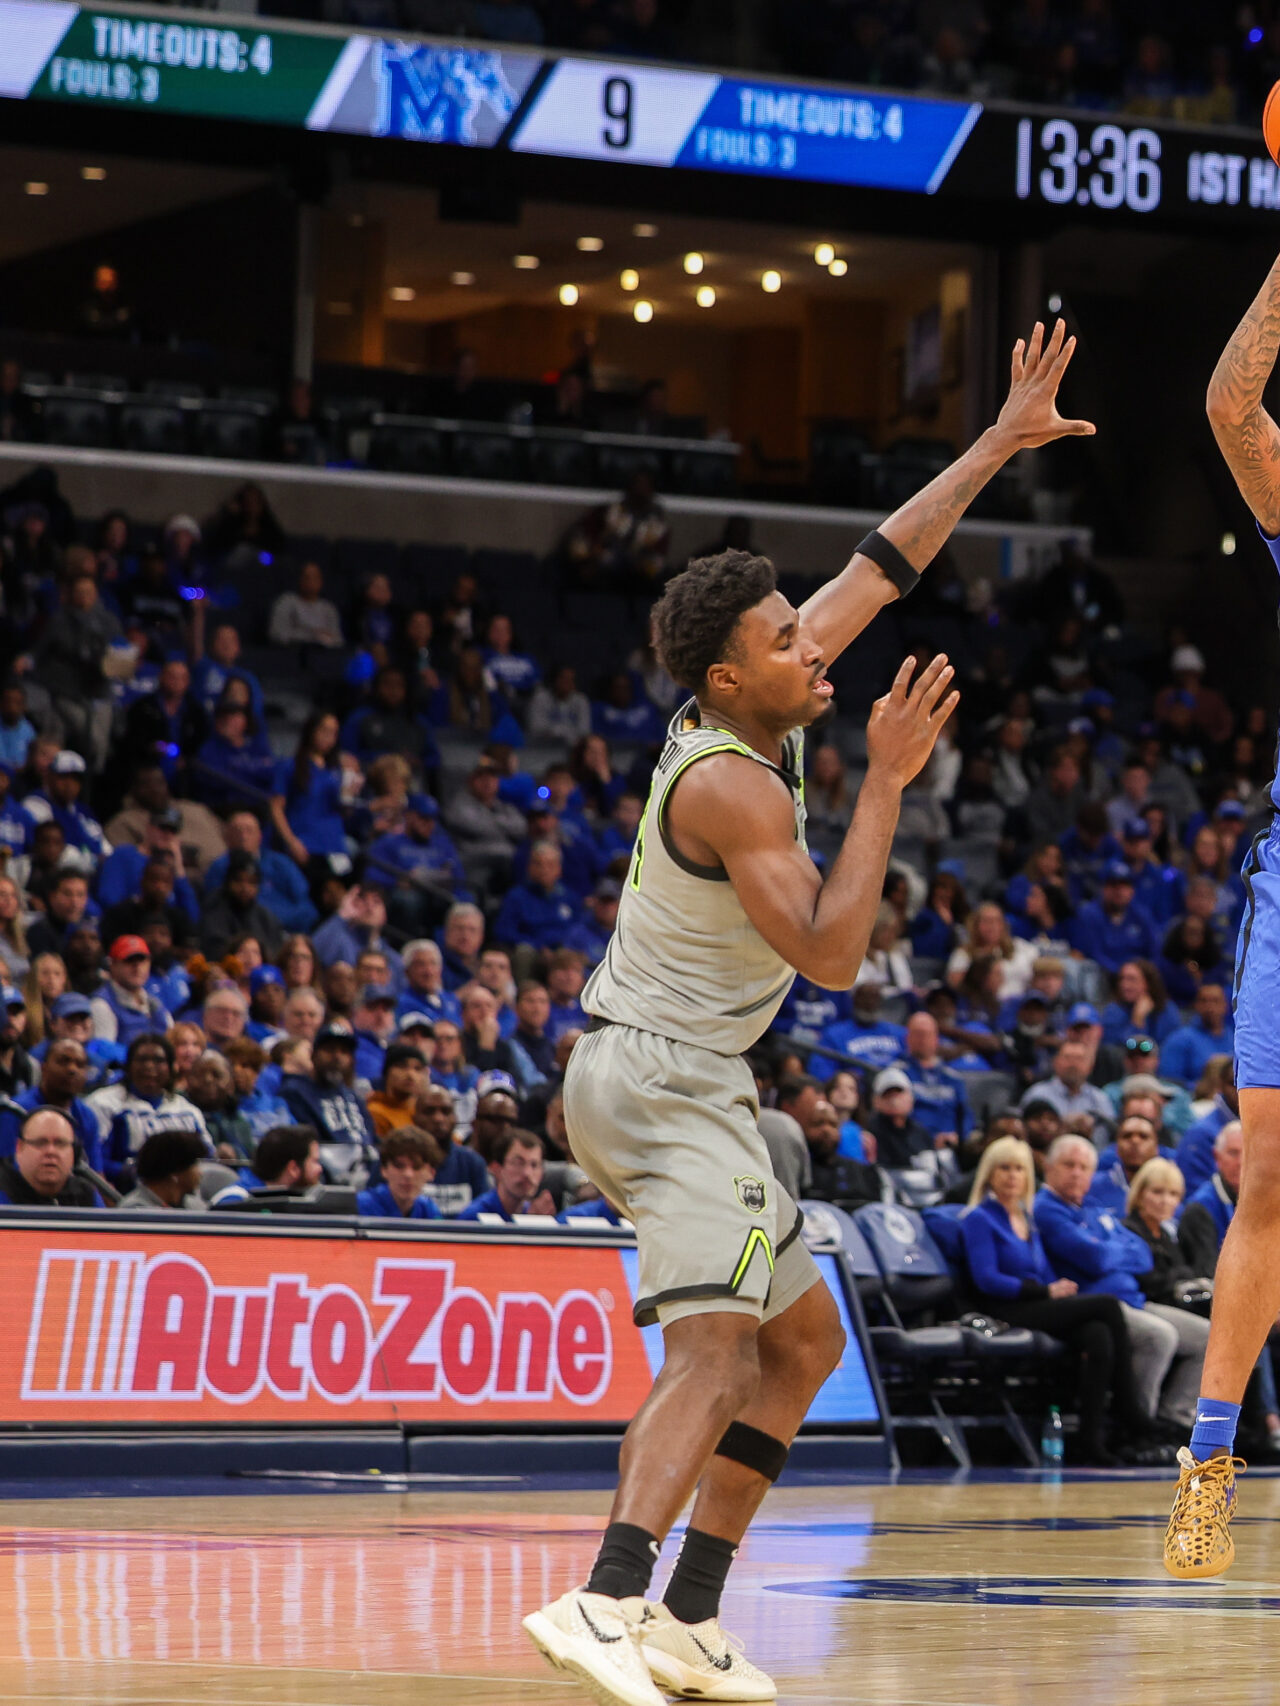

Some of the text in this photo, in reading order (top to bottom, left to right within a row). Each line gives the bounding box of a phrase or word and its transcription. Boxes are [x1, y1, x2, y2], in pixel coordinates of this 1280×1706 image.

[92, 16, 249, 73] TIMEOUTS:
[50, 55, 138, 101] FOULS:
[602, 75, 633, 150] 9
[739, 86, 881, 141] TIMEOUTS:
[1015, 117, 1163, 213] 13:36
[126, 1250, 613, 1405] AutoZone
